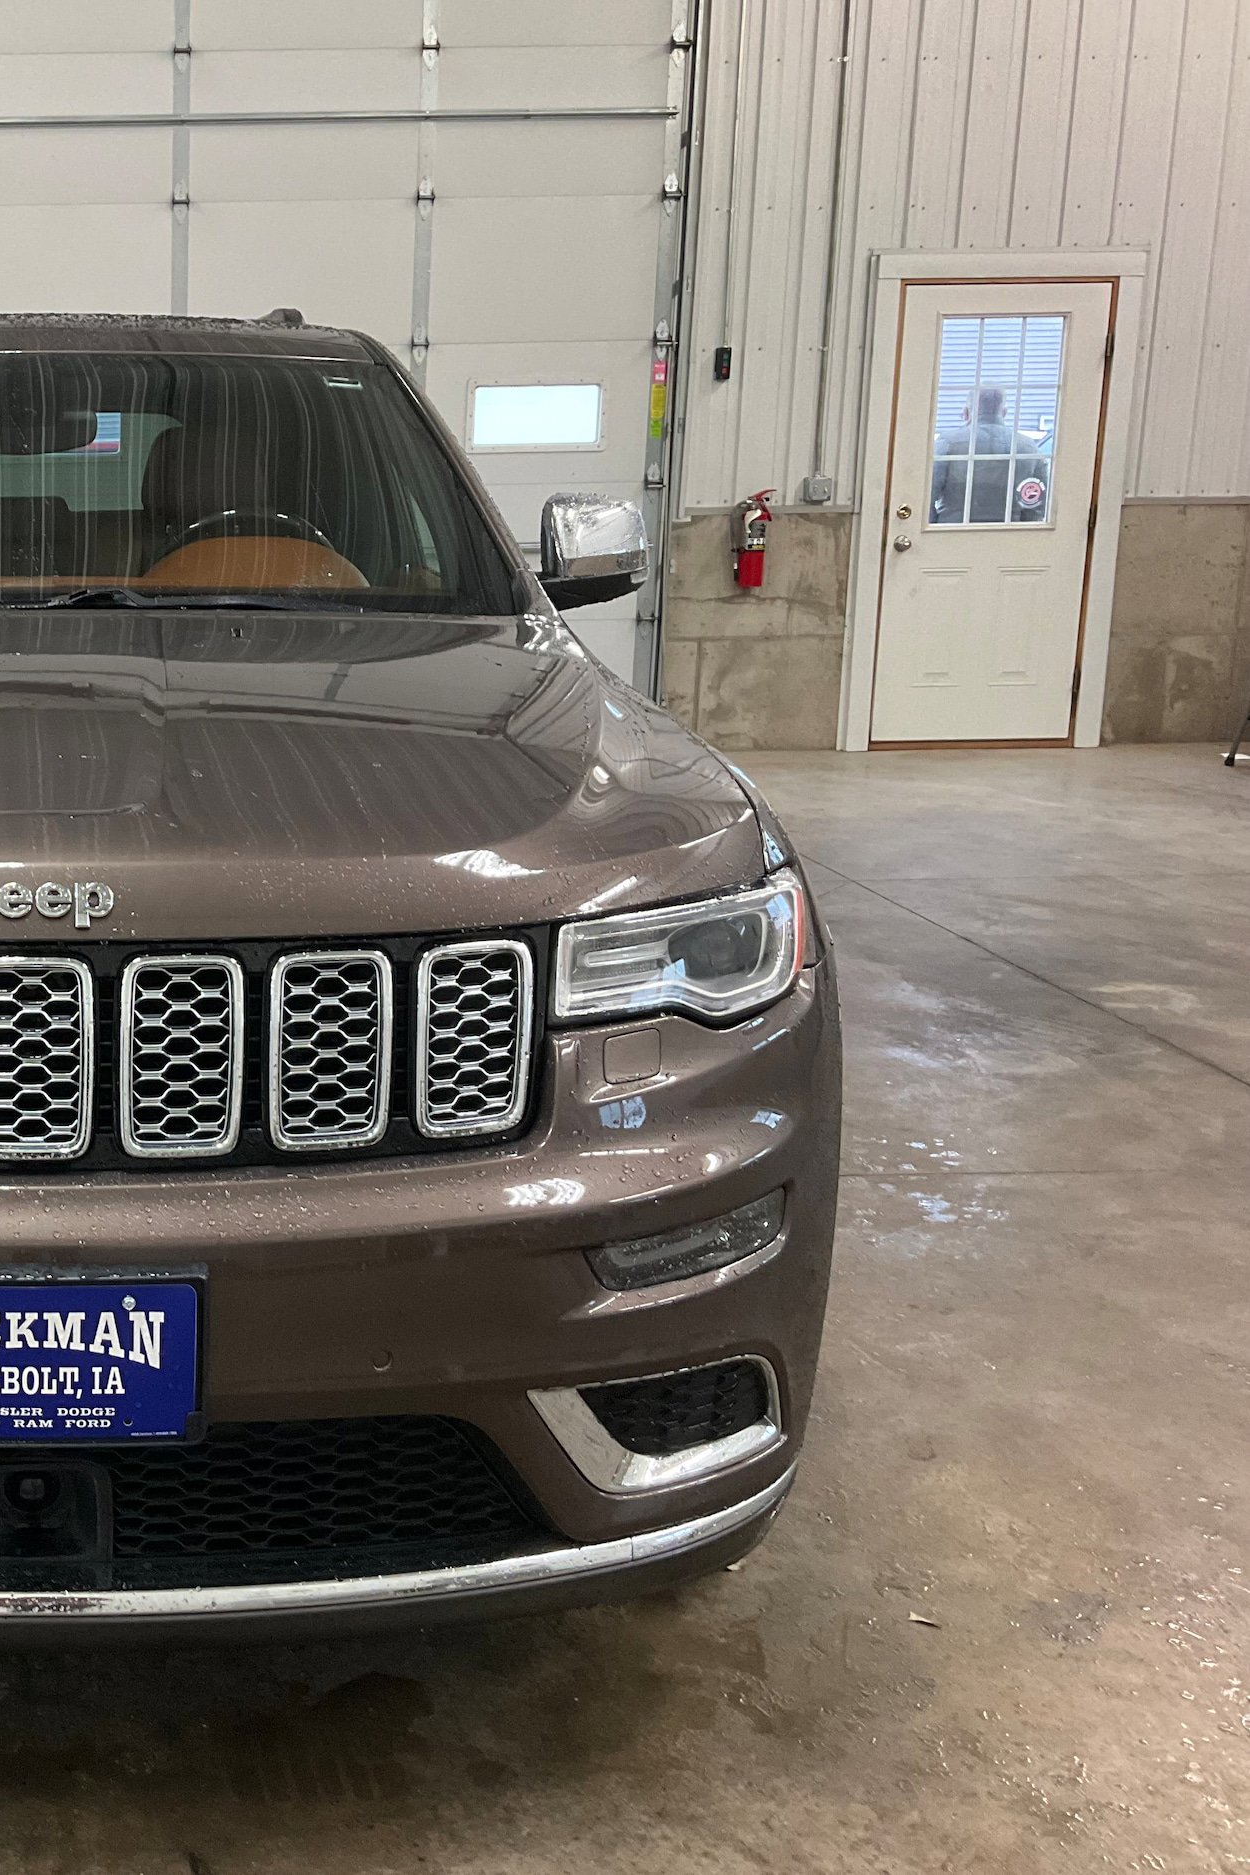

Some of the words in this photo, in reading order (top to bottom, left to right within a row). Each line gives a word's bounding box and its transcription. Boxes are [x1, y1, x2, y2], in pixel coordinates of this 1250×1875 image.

[92, 1366, 125, 1395] IA
[57, 1406, 116, 1417] DODGE
[13, 1418, 53, 1428] RAM
[65, 1418, 111, 1428] FORD
